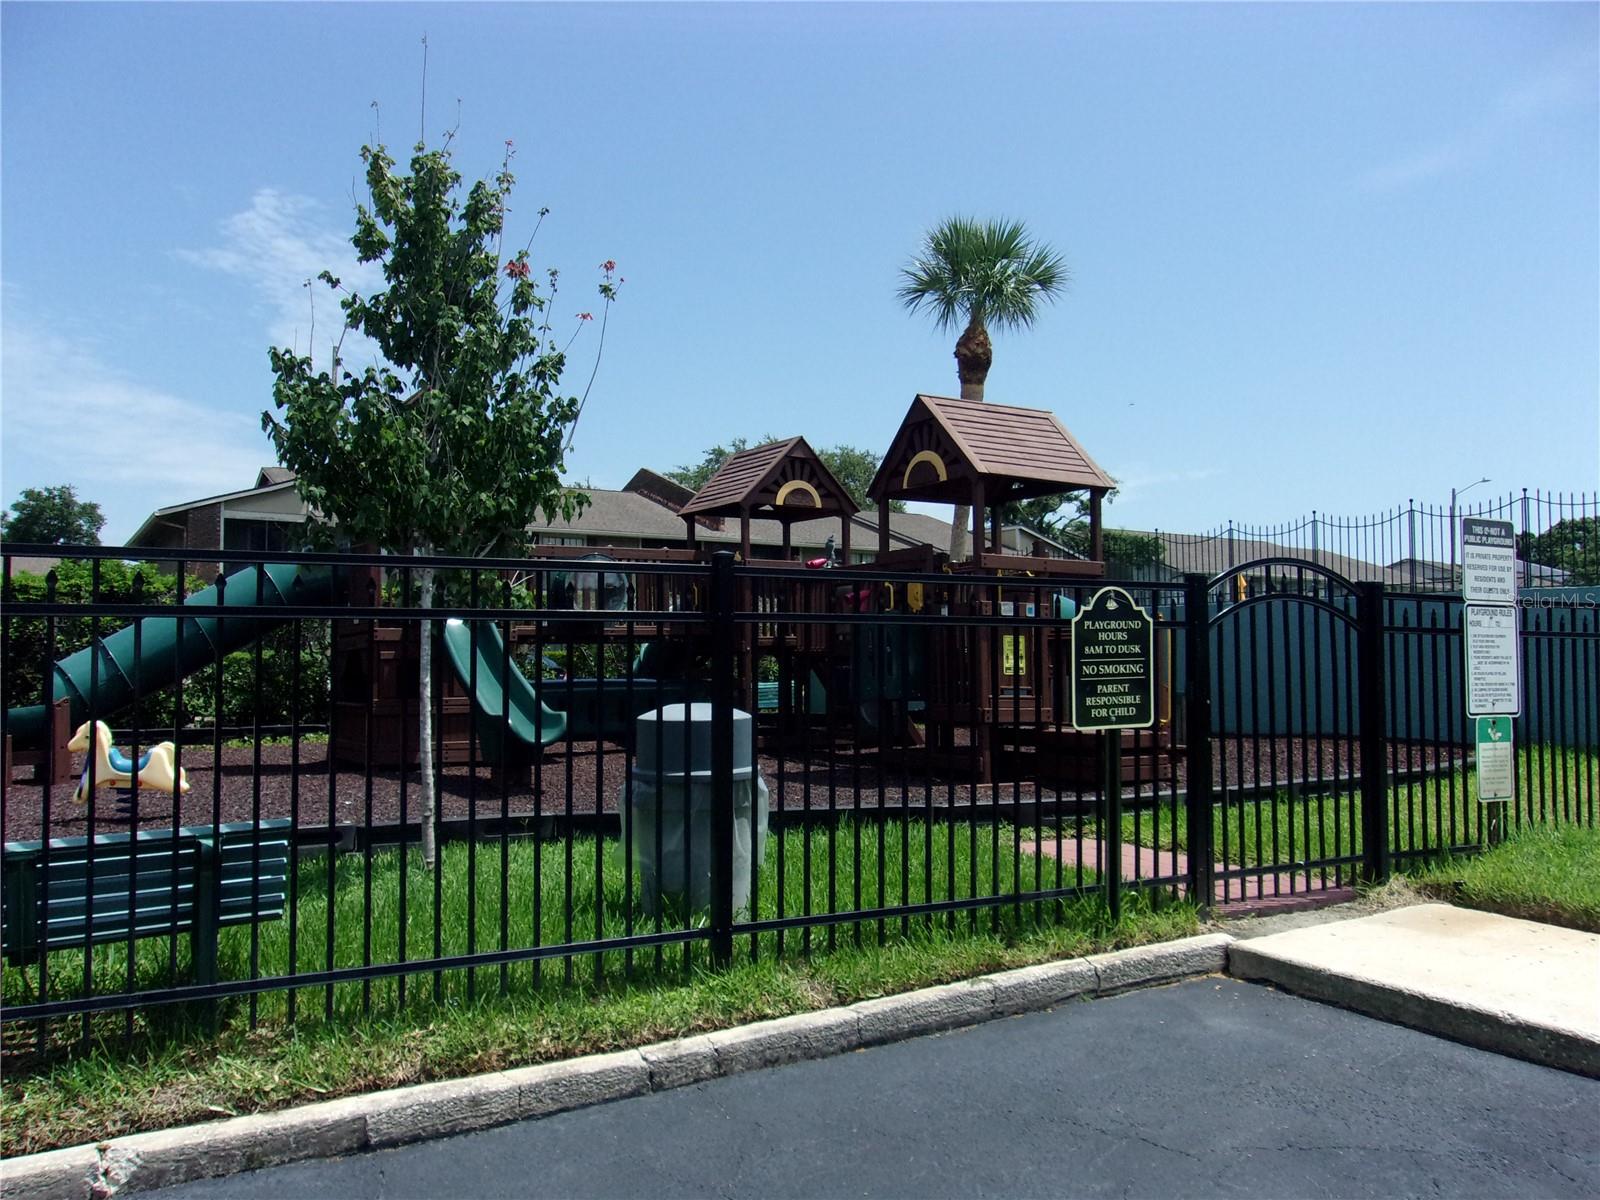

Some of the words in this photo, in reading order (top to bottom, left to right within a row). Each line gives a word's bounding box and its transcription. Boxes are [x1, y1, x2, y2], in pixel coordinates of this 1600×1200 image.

[1472, 526, 1483, 534] THIS
[1490, 528, 1500, 536] NOT
[1482, 537, 1512, 545] PLAYGROUND
[1084, 621, 1141, 629] PLAYGROUND
[1098, 632, 1128, 640] HOURS
[1084, 646, 1102, 654] 8AM
[1105, 645, 1117, 654] TO
[1118, 645, 1141, 653] DUSK
[1082, 665, 1097, 674] NO
[1099, 664, 1144, 674] SMOKING
[1097, 684, 1129, 693] PARENT
[1086, 695, 1140, 706] RESPONSIBLE
[1091, 708, 1108, 717] FOR
[1108, 707, 1136, 718] CHILD
